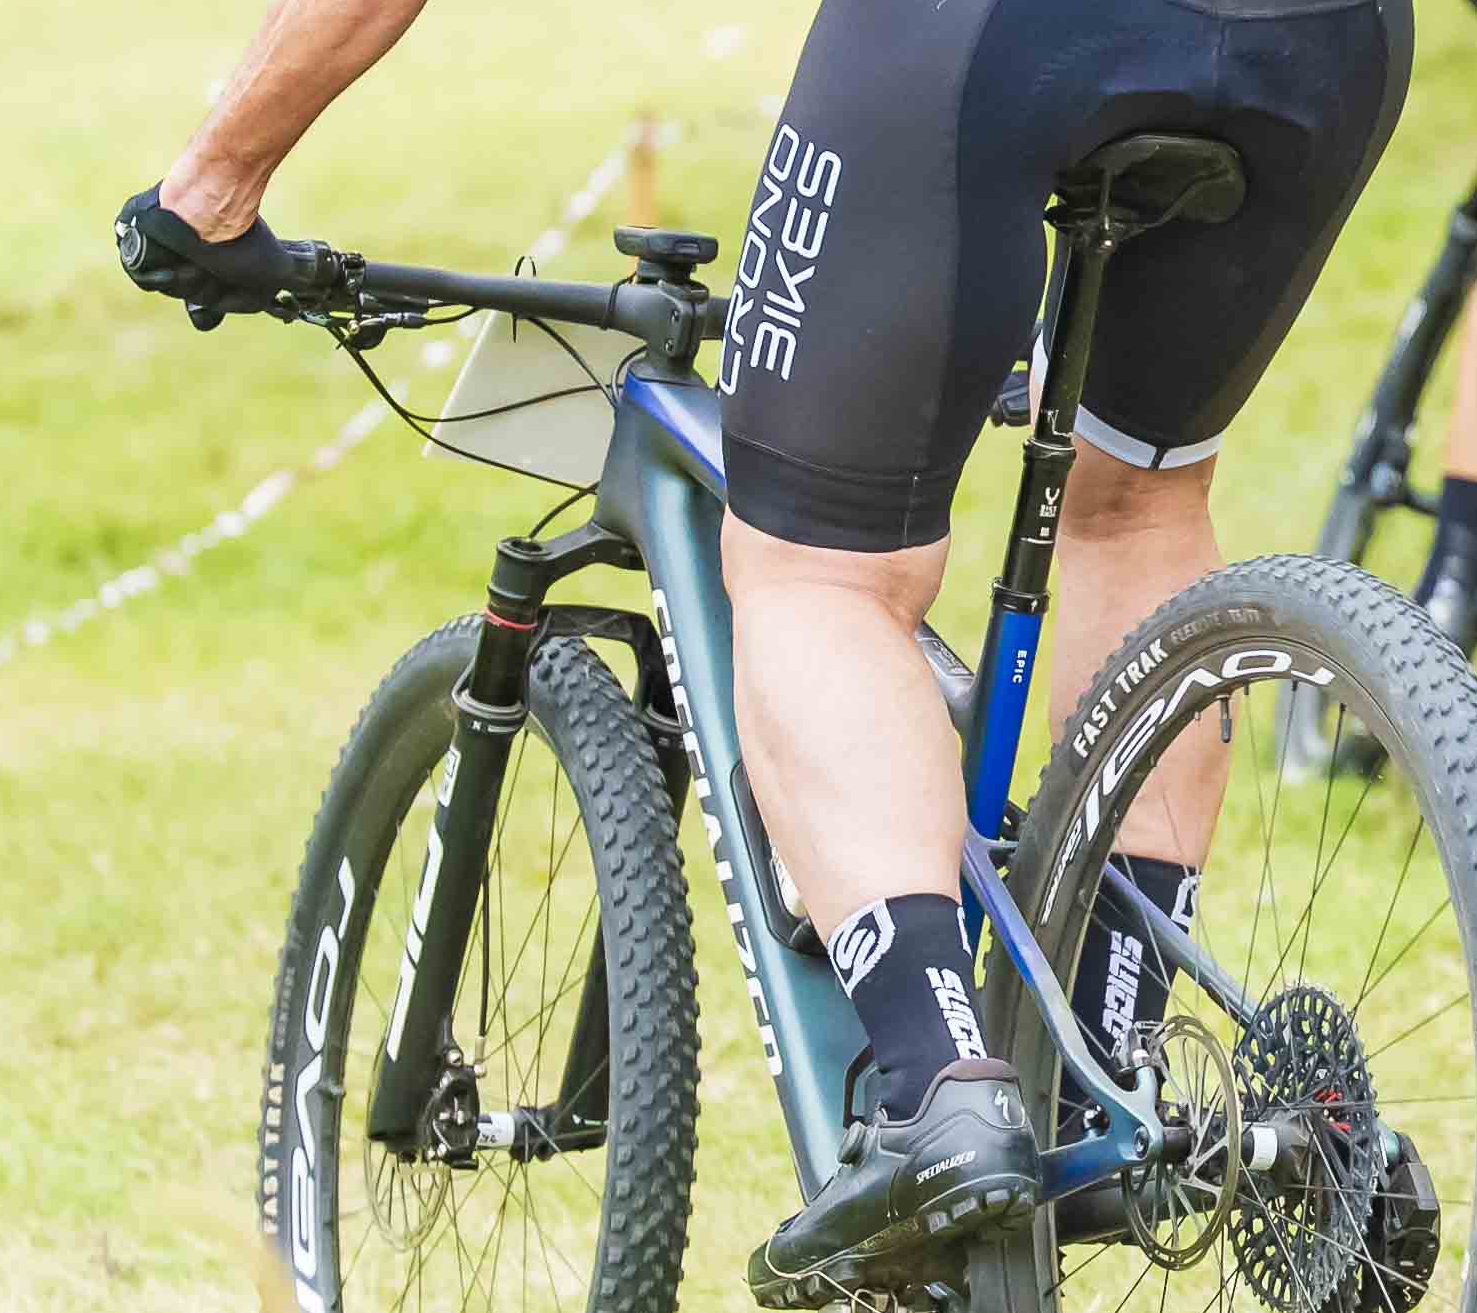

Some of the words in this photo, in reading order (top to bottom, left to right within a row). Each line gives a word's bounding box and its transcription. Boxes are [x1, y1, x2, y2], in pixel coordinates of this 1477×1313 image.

[718, 123, 800, 396] CRONO
[749, 141, 842, 381] BIKES
[1012, 649, 1028, 684] EPIC
[1073, 690, 1117, 758] FAST
[1115, 638, 1169, 694] TRAK
[265, 1062, 285, 1146] TRAK
[263, 1156, 279, 1235] FAST
[916, 1150, 977, 1185] SPECIALIZED
